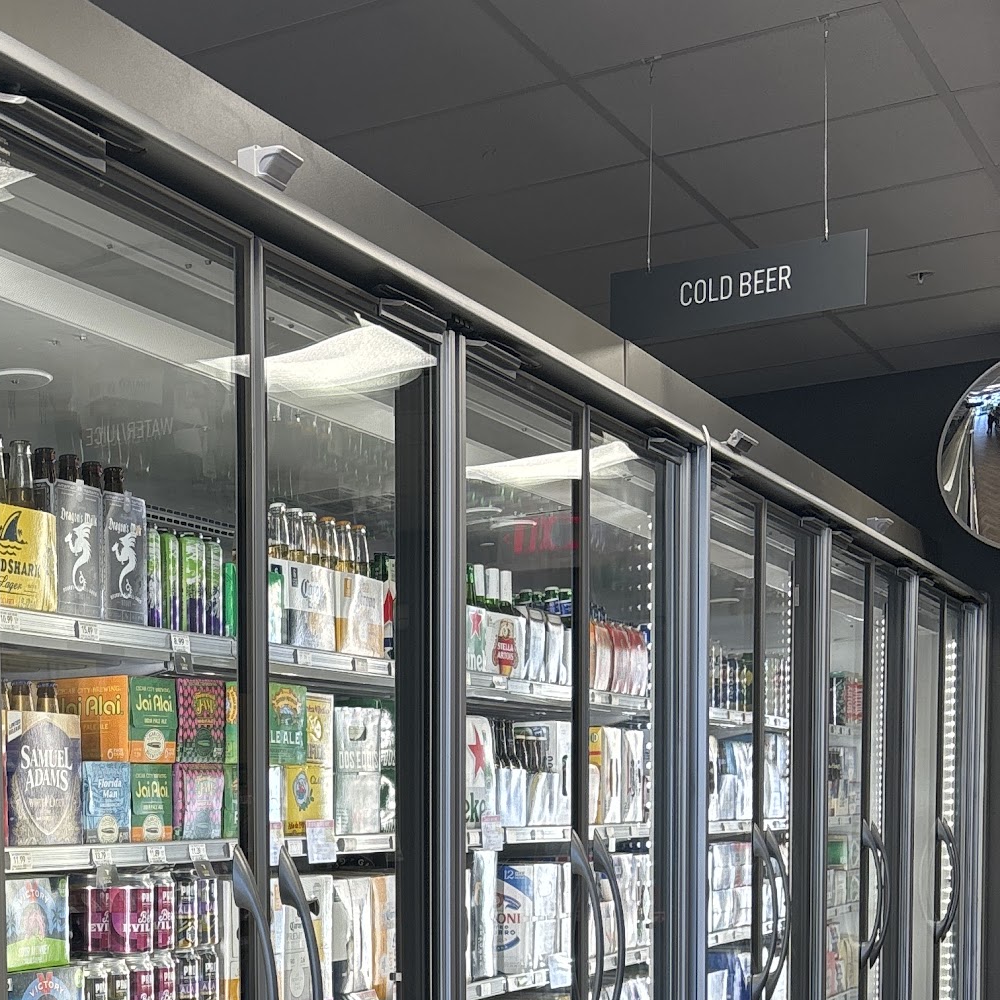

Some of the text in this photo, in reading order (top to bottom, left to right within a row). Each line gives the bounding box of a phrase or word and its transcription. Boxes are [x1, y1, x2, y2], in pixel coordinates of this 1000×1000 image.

[680, 265, 791, 307] COLD BEER
[497, 641, 514, 651] STELLA
[497, 650, 515, 661] ARTOIS
[135, 694, 151, 711] Jai
[20, 745, 73, 770] SAMUEL
[339, 750, 379, 770] DOS EQUIS
[25, 769, 68, 793] ADAMS
[98, 779, 122, 789] Florida
[135, 781, 150, 797] Jai
[102, 788, 118, 799] Man
[29, 980, 66, 998] VICTORY
